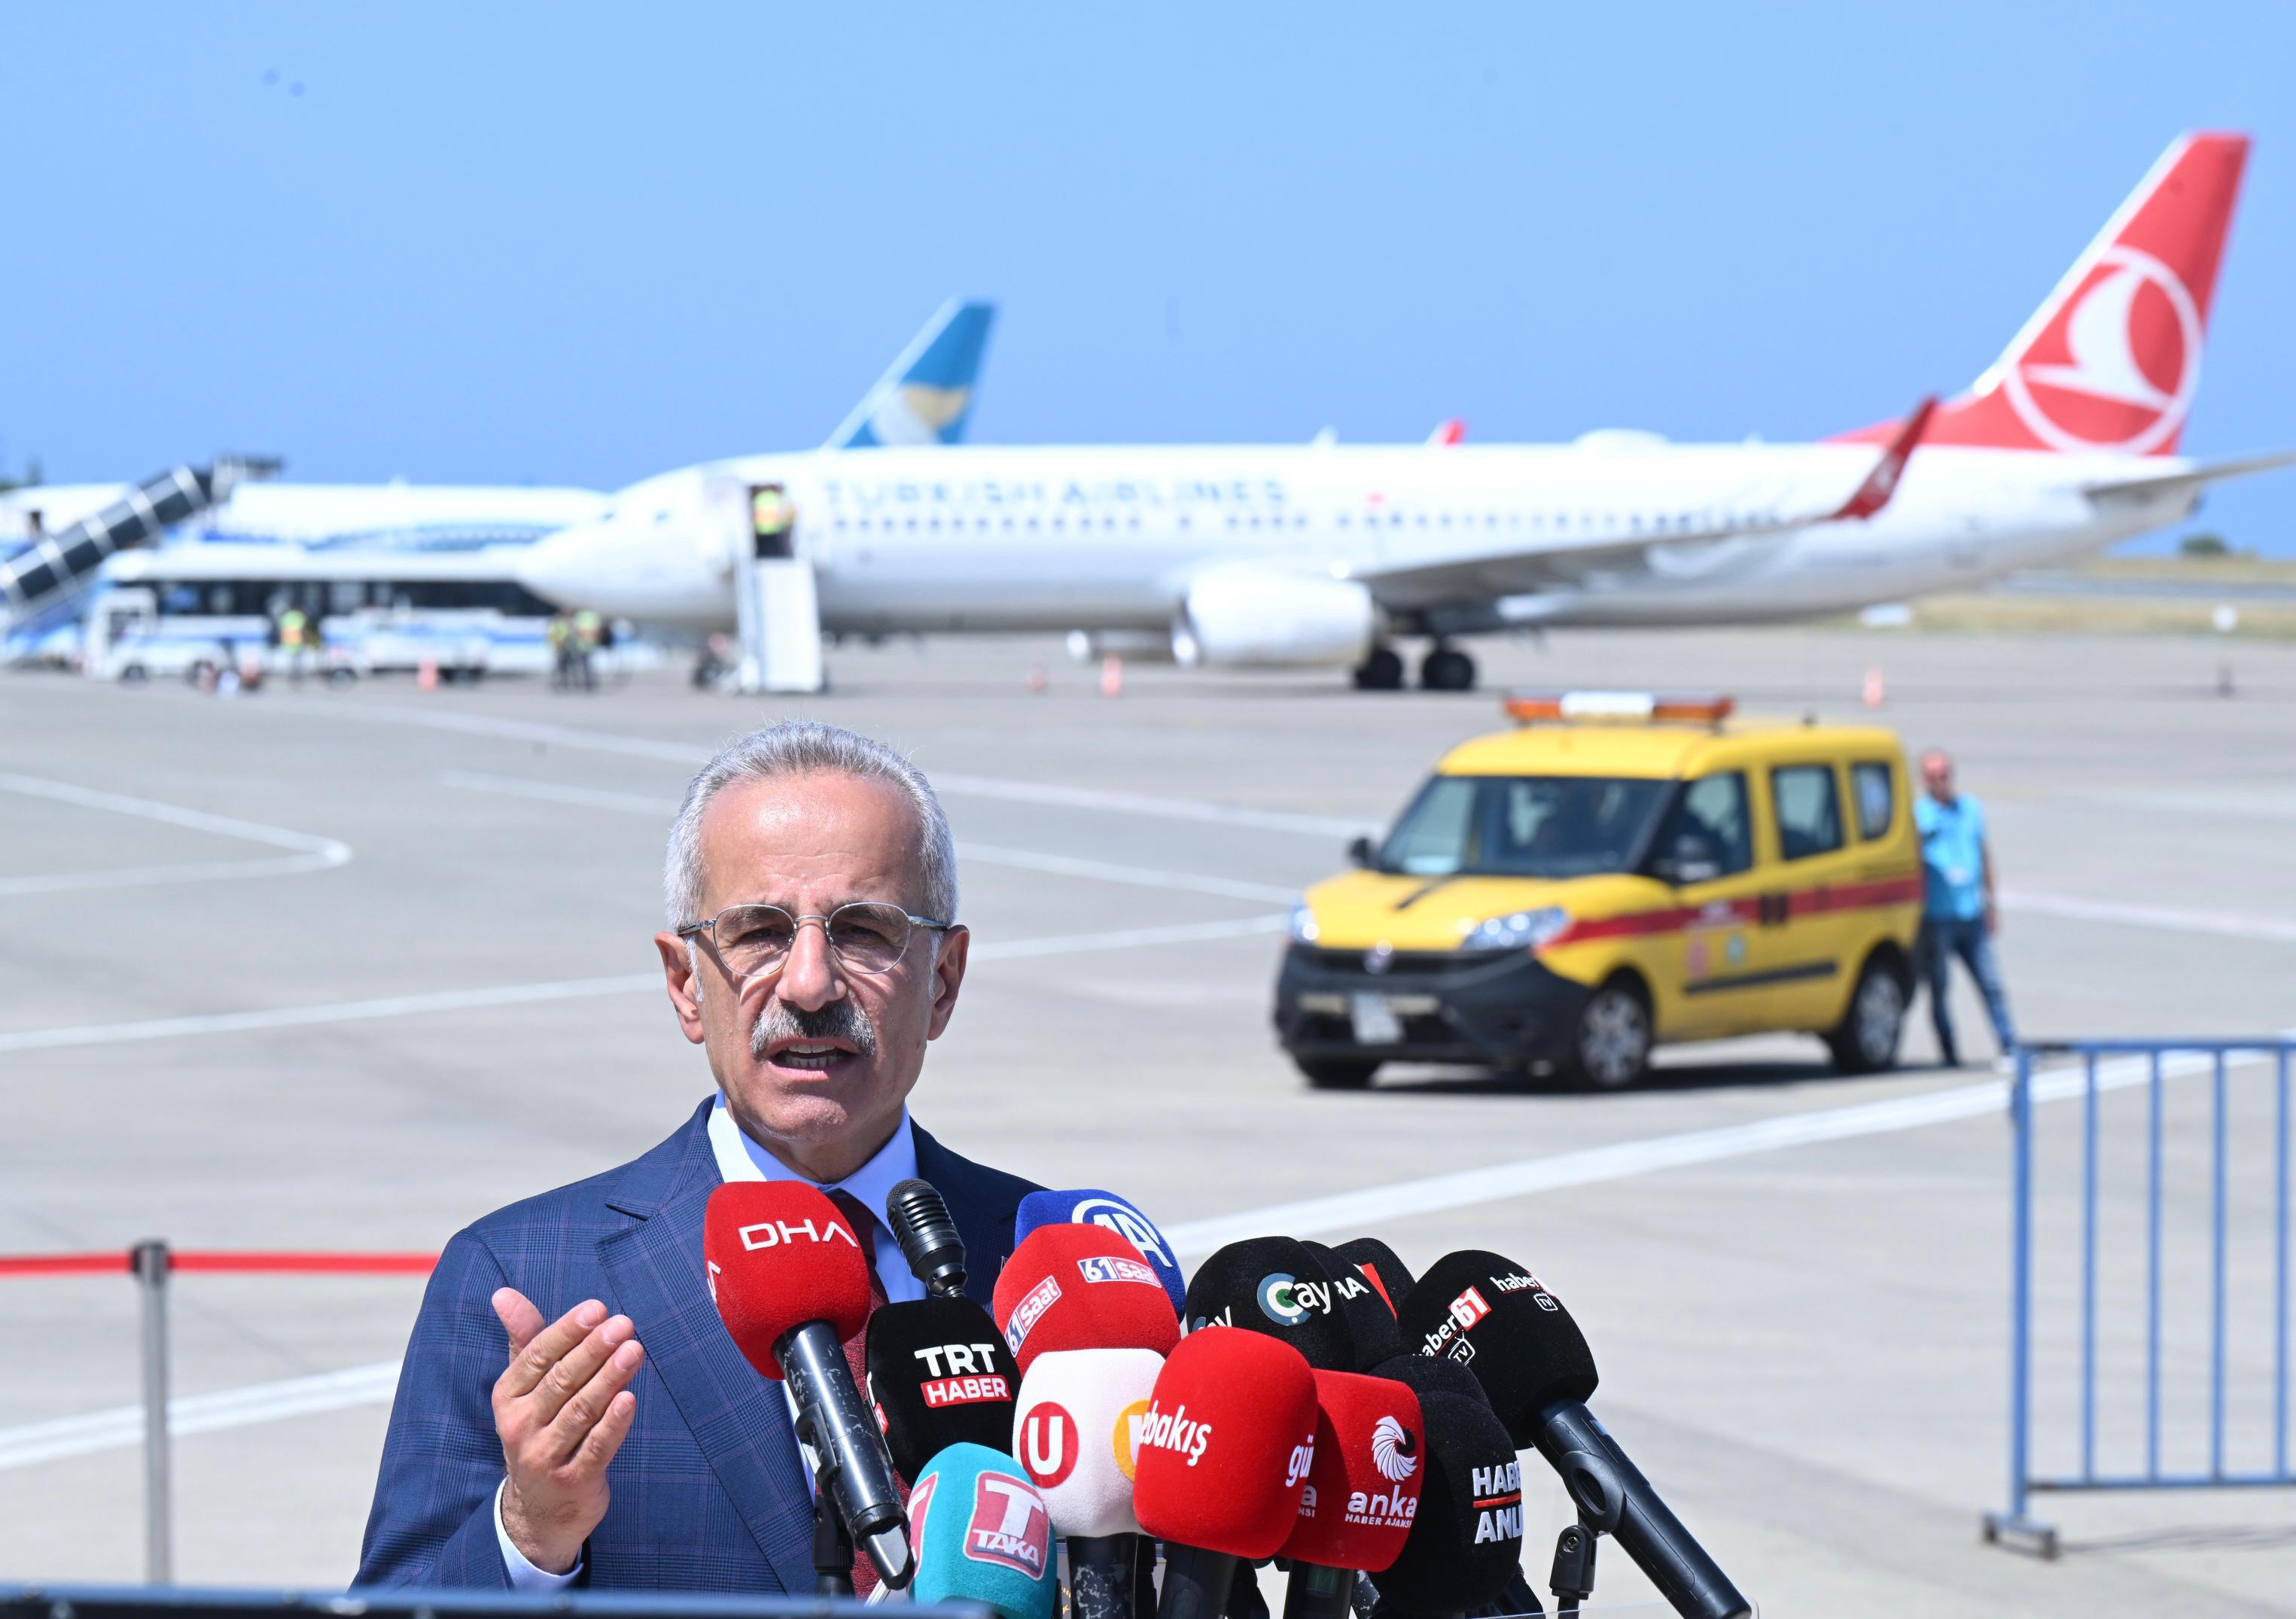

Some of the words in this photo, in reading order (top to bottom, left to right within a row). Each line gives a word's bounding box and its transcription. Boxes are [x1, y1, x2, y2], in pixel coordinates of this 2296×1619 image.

[825, 481, 1047, 504] TURKISH
[1062, 480, 1287, 505] AIRLINES
[738, 1219, 858, 1251] DHA
[914, 1344, 995, 1377] TRT
[926, 1377, 1008, 1404] HABER
[1028, 1416, 1063, 1475] U
[1347, 1485, 1417, 1518] anka
[1345, 1513, 1382, 1526] HABER
[973, 1529, 1040, 1567] TAKA
